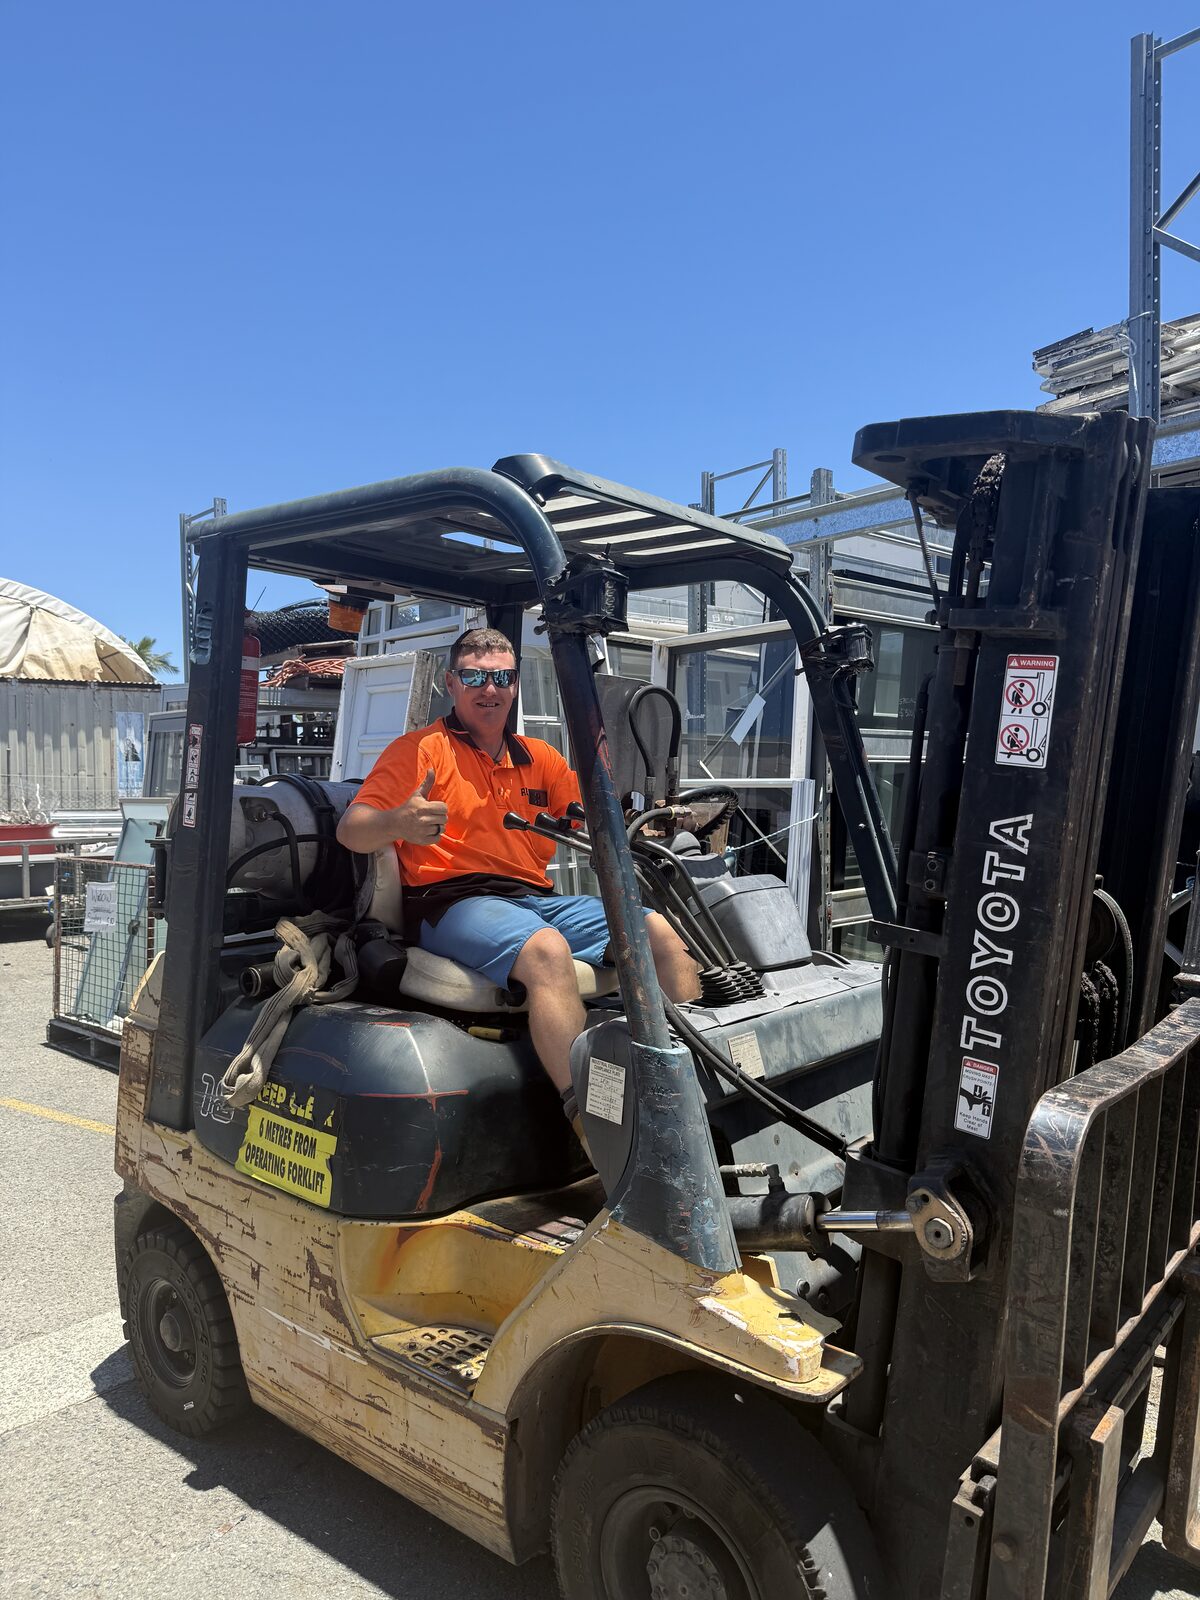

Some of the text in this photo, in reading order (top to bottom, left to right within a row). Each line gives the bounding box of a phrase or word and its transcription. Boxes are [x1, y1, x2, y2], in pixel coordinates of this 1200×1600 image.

[1019, 659, 1055, 667] WARNING
[959, 813, 1034, 1051] TOYOTA
[972, 1063, 994, 1072] DANGER
[257, 1081, 287, 1109] EEP
[960, 1112, 988, 1125] Keep Hands
[963, 1118, 977, 1126] Clear
[259, 1117, 317, 1159] 6 METRES FROM
[245, 1143, 325, 1195] OPERATING FORKLIFT
